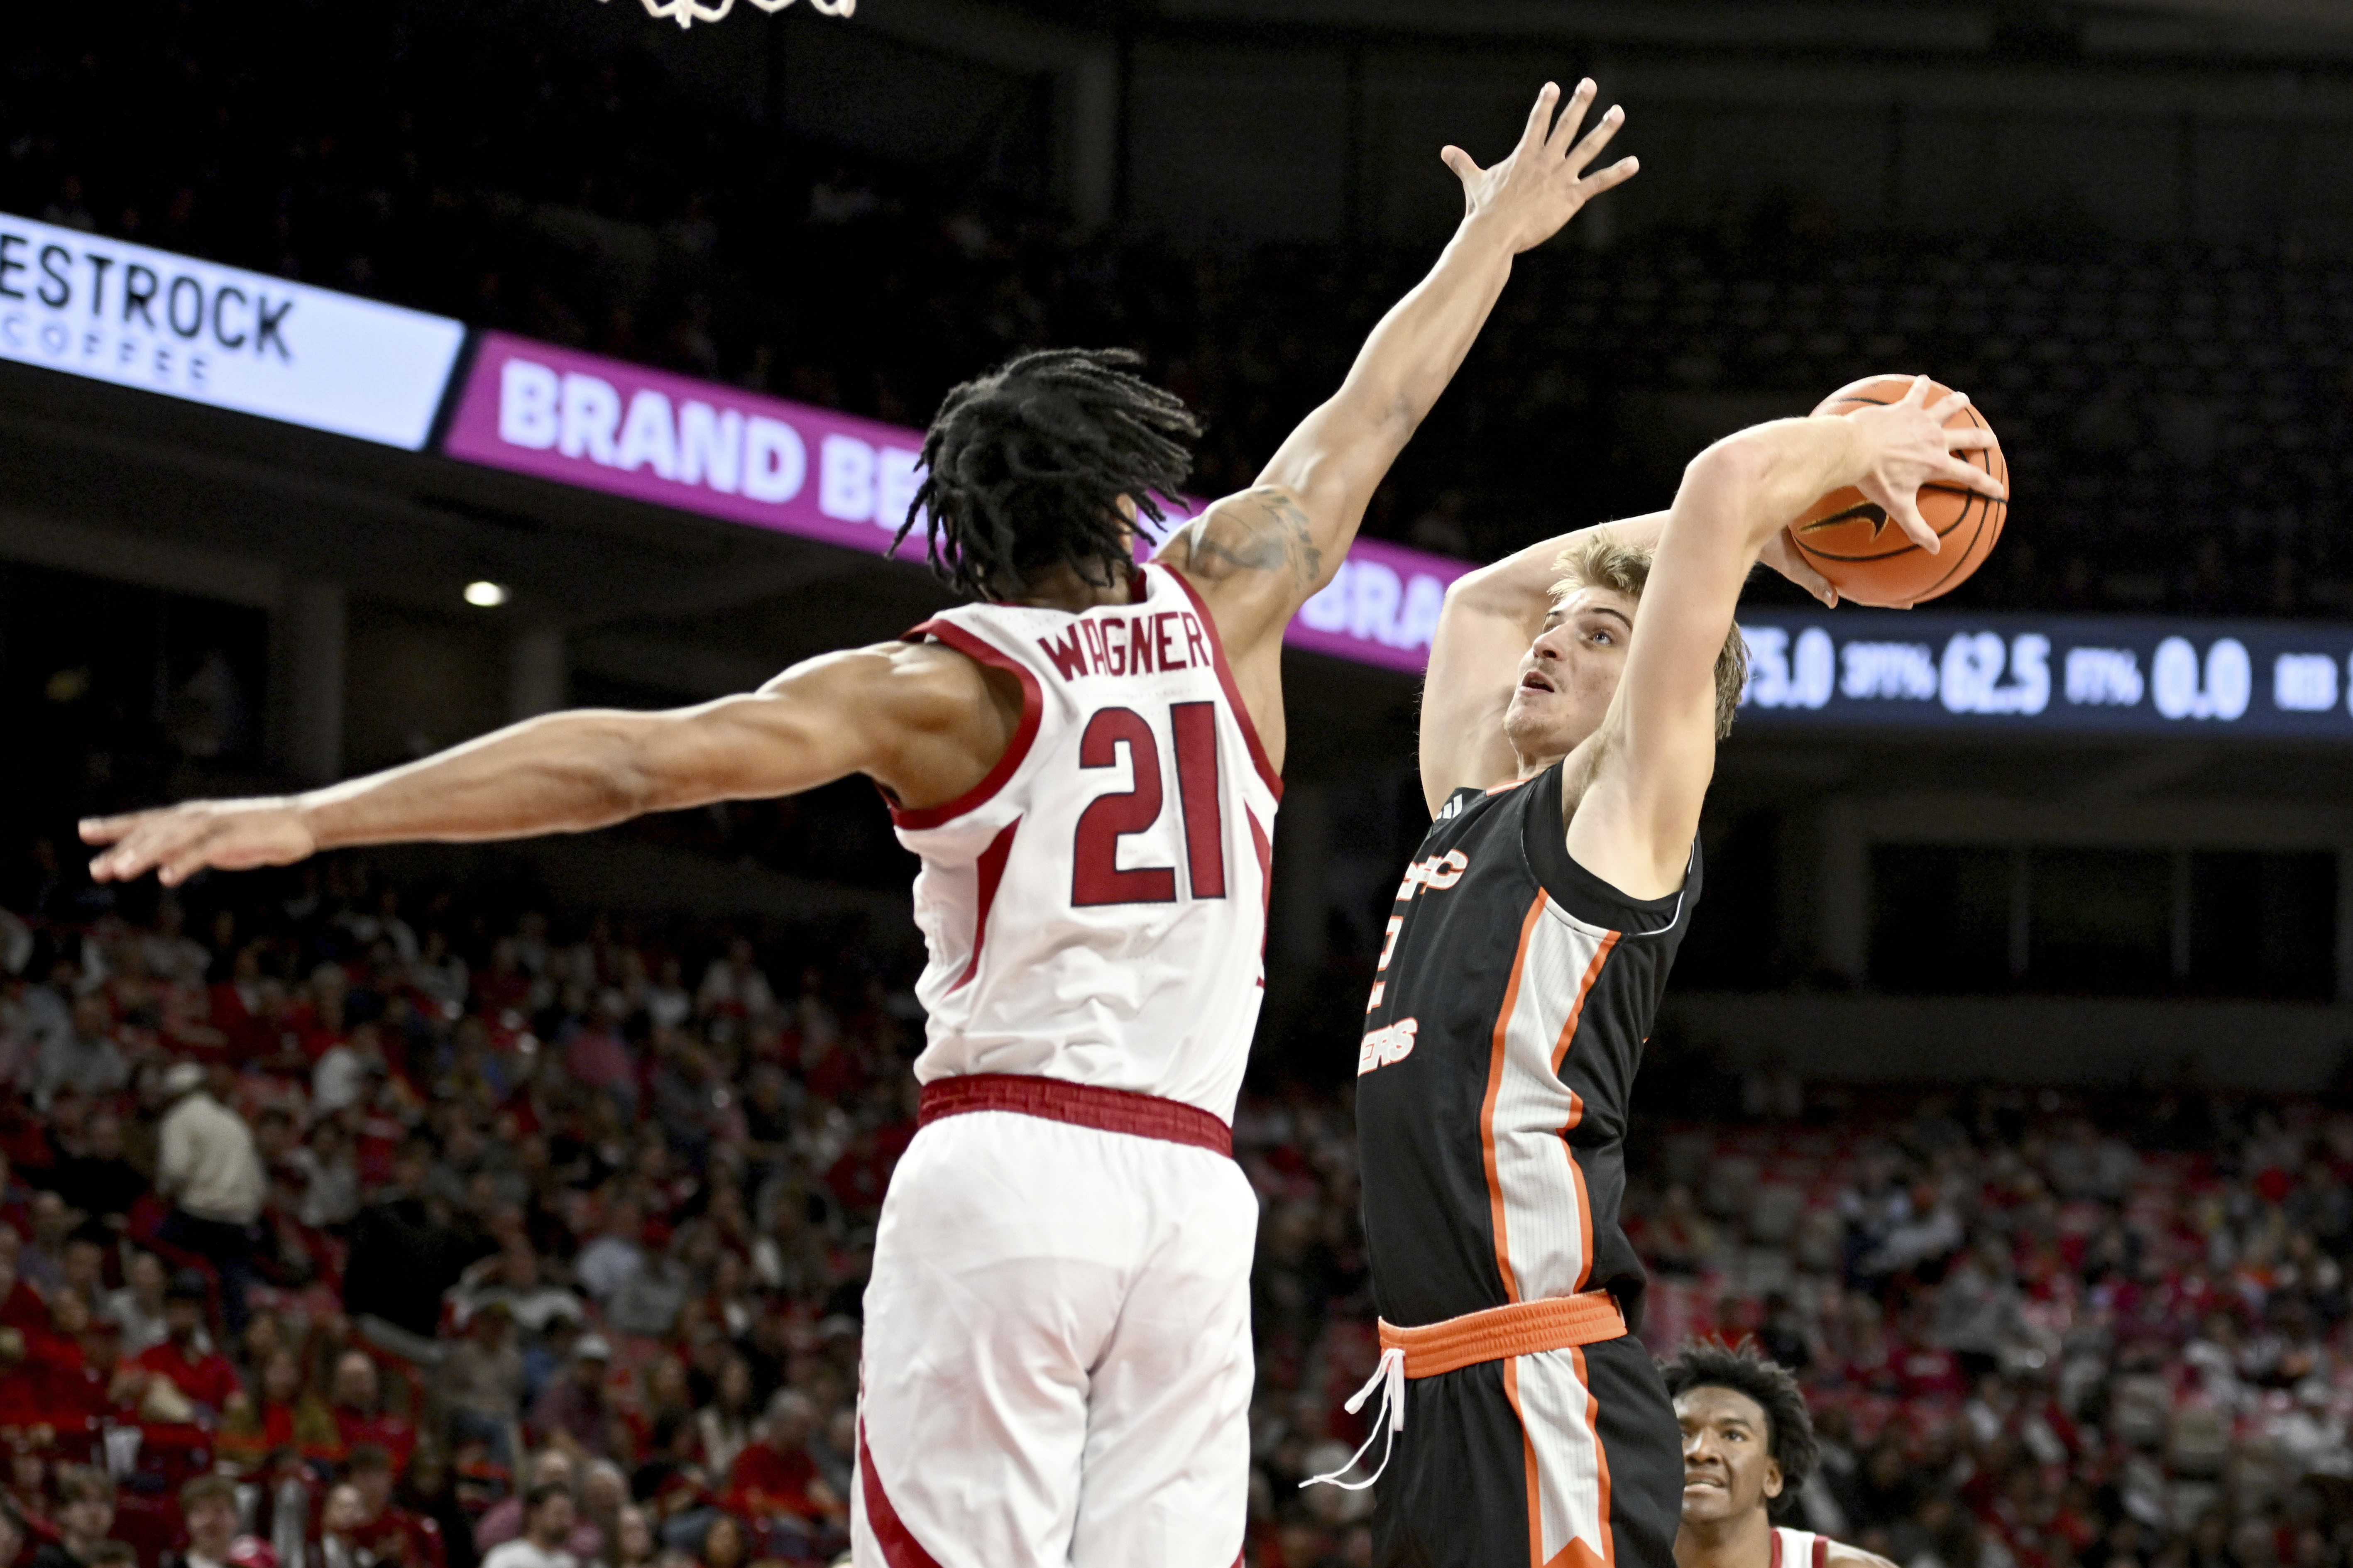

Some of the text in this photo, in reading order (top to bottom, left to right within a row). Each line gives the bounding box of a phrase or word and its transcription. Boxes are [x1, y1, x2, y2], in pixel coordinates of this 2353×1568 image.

[1, 314, 213, 383] COFFEE
[498, 358, 807, 504] BRAND
[1037, 611, 1211, 682] WAGNER
[1940, 633, 2050, 713] 62.5
[2151, 636, 2252, 721] 0.0
[1071, 701, 1226, 908] 21
